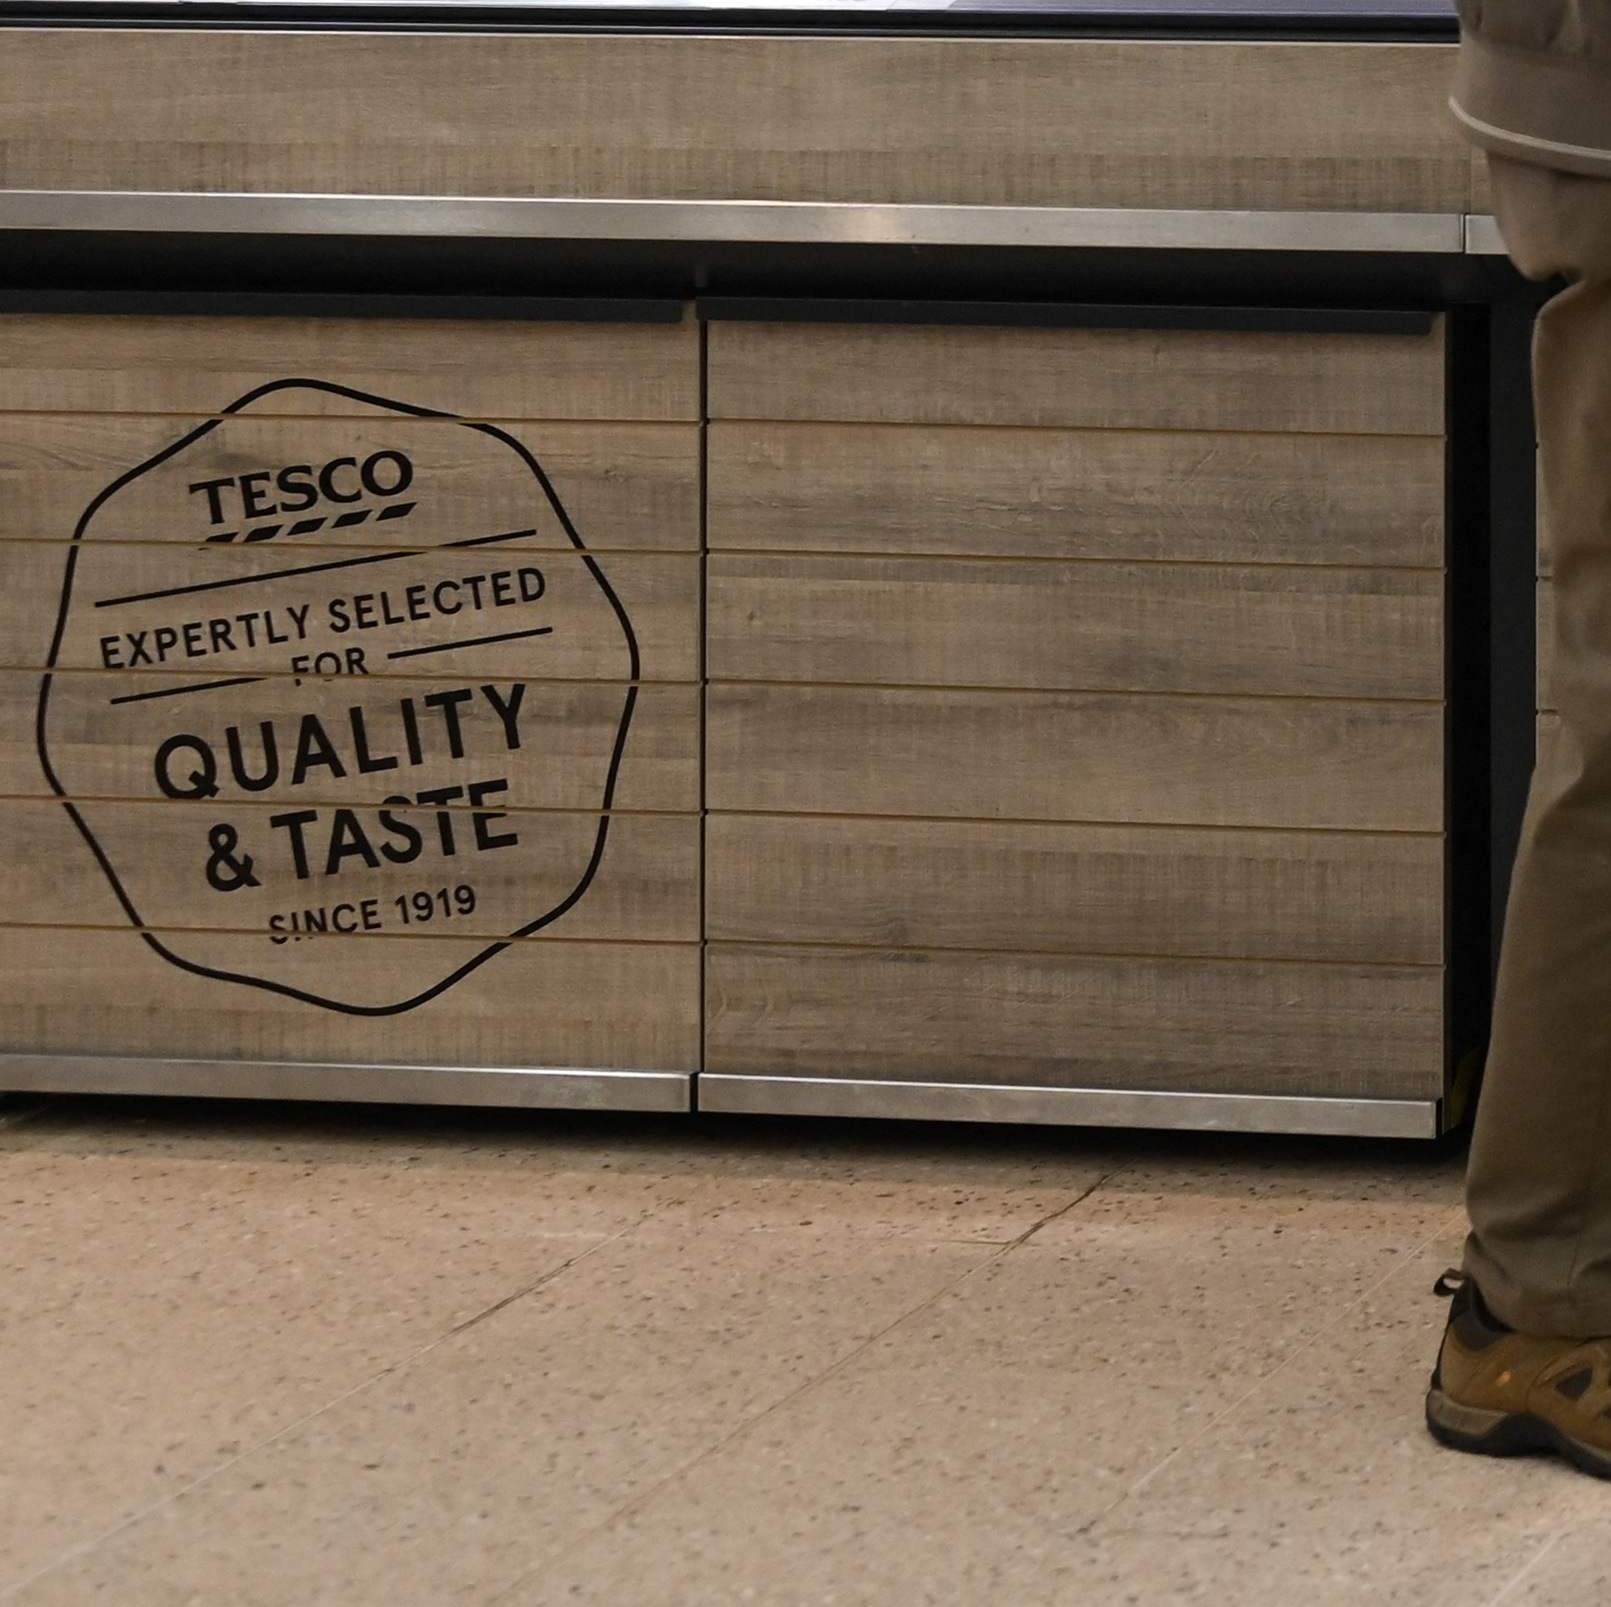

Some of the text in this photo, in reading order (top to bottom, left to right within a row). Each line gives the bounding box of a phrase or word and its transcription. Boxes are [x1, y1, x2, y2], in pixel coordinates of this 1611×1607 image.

[189, 450, 414, 525] TESCO
[99, 567, 547, 669] EXPERTLY SELECTED
[291, 647, 369, 686] FOR
[154, 683, 526, 800] QUALITY
[205, 778, 519, 891] & TASTE
[269, 884, 477, 944] SINCE 1919
